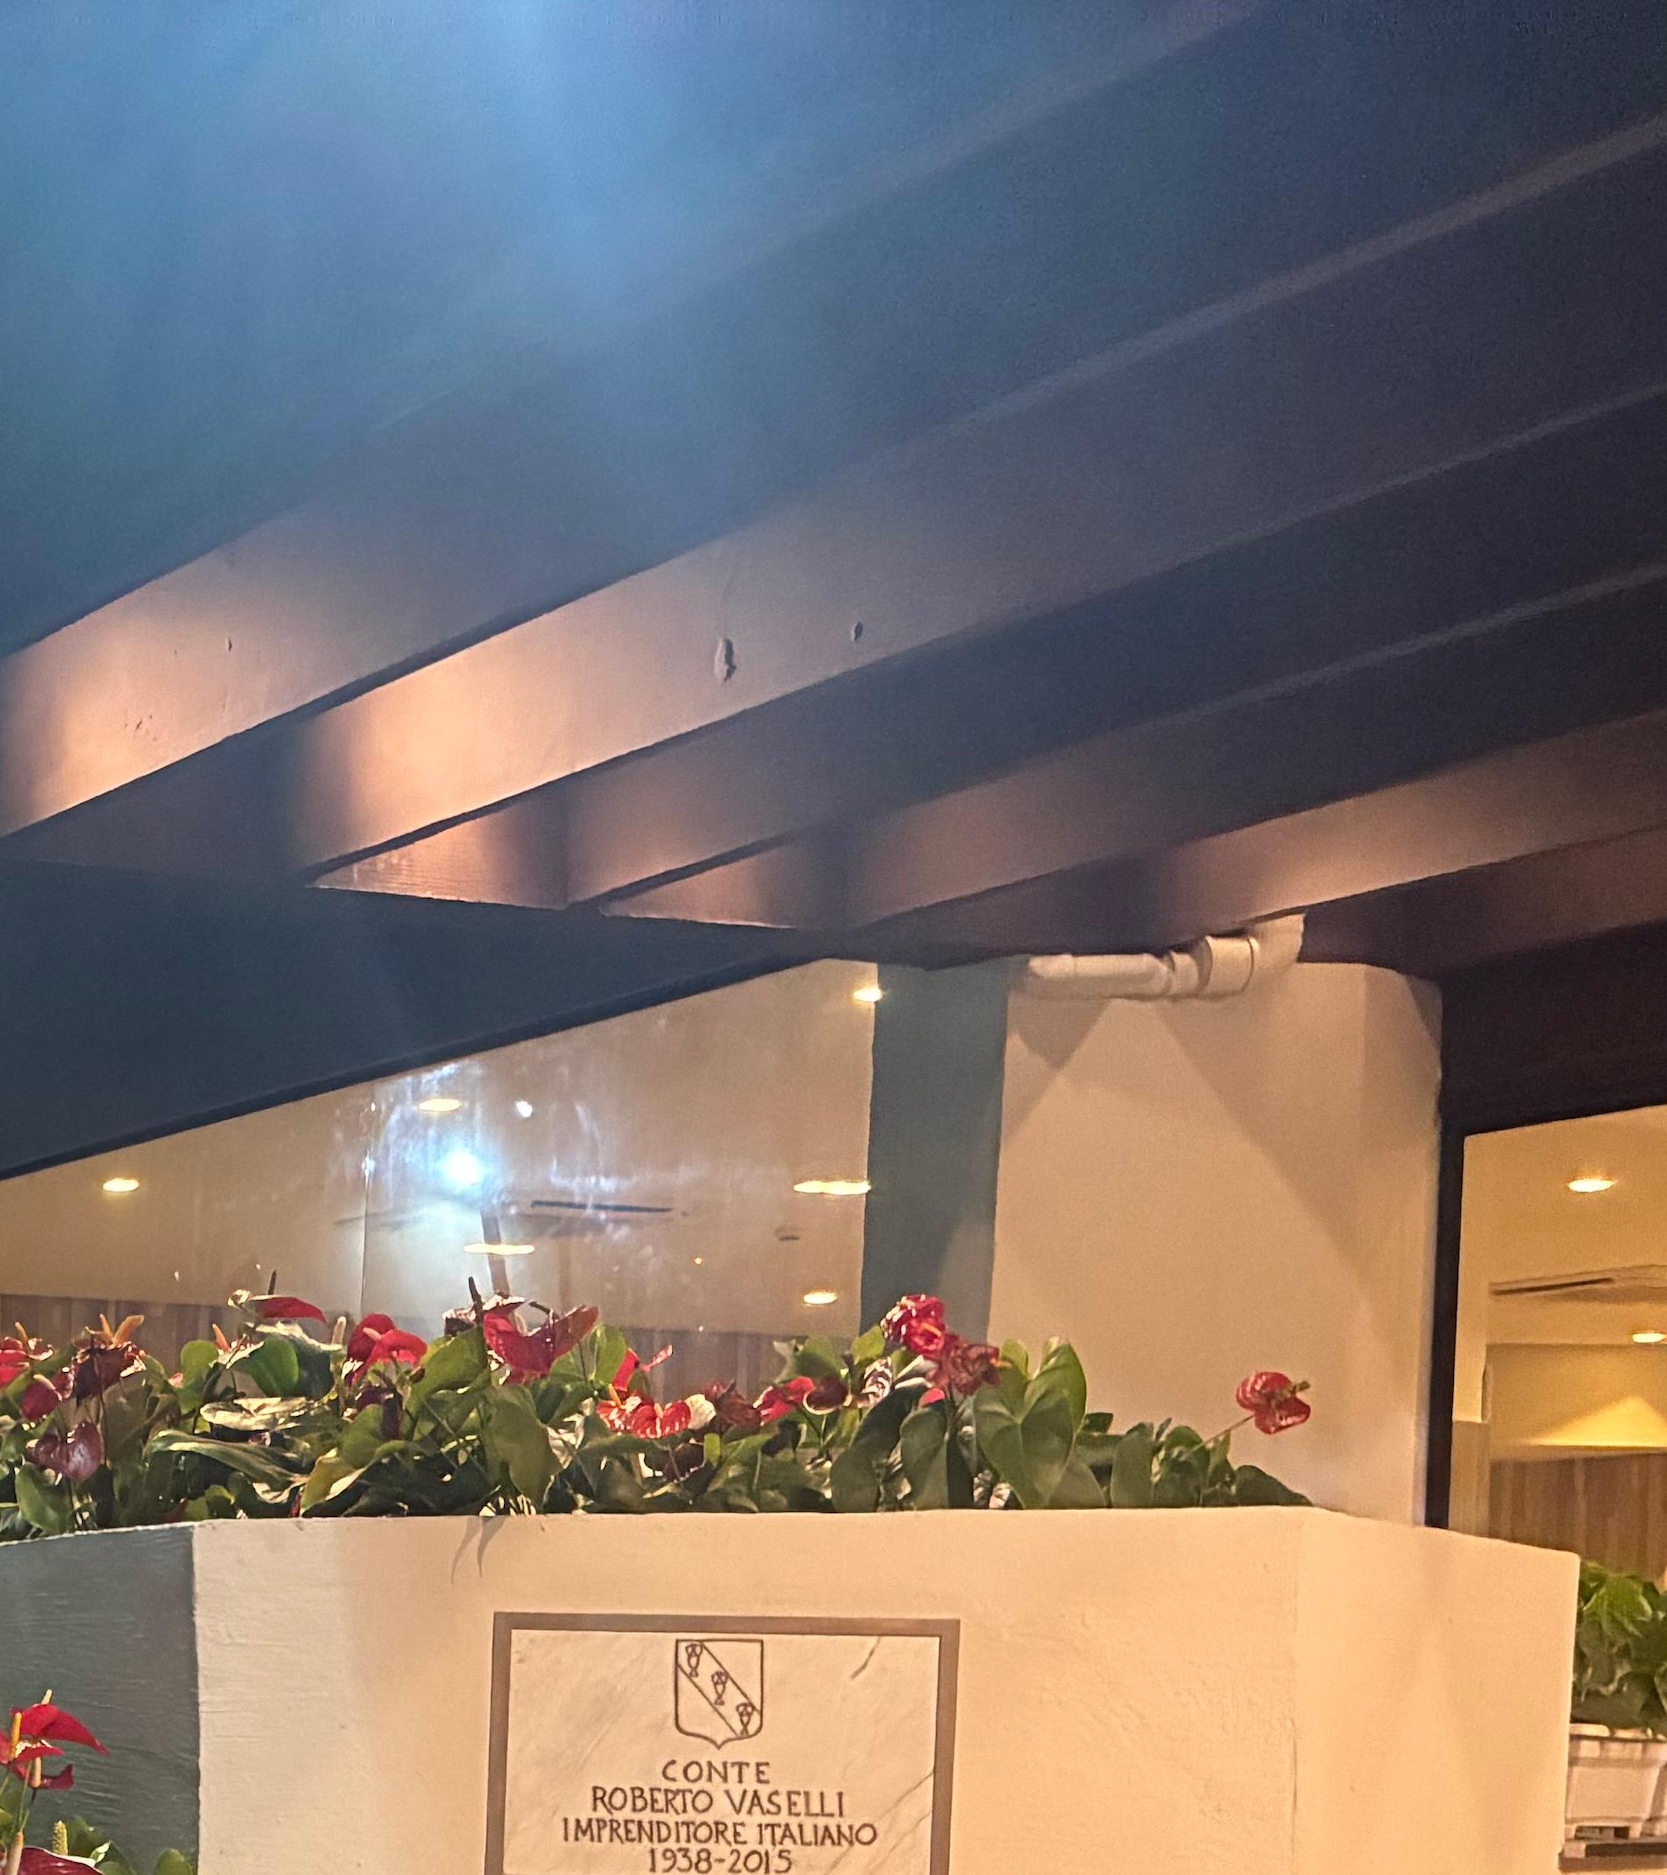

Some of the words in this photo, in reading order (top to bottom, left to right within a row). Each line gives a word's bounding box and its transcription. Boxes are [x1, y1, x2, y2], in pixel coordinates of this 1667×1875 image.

[661, 1759, 771, 1785] CONTE
[591, 1786, 714, 1816] ROBERTO
[724, 1789, 845, 1818] VASELLI
[562, 1817, 748, 1846] IMPRENDITORE
[756, 1822, 879, 1847] ITALIANO
[648, 1847, 794, 1875] 1938-2015
